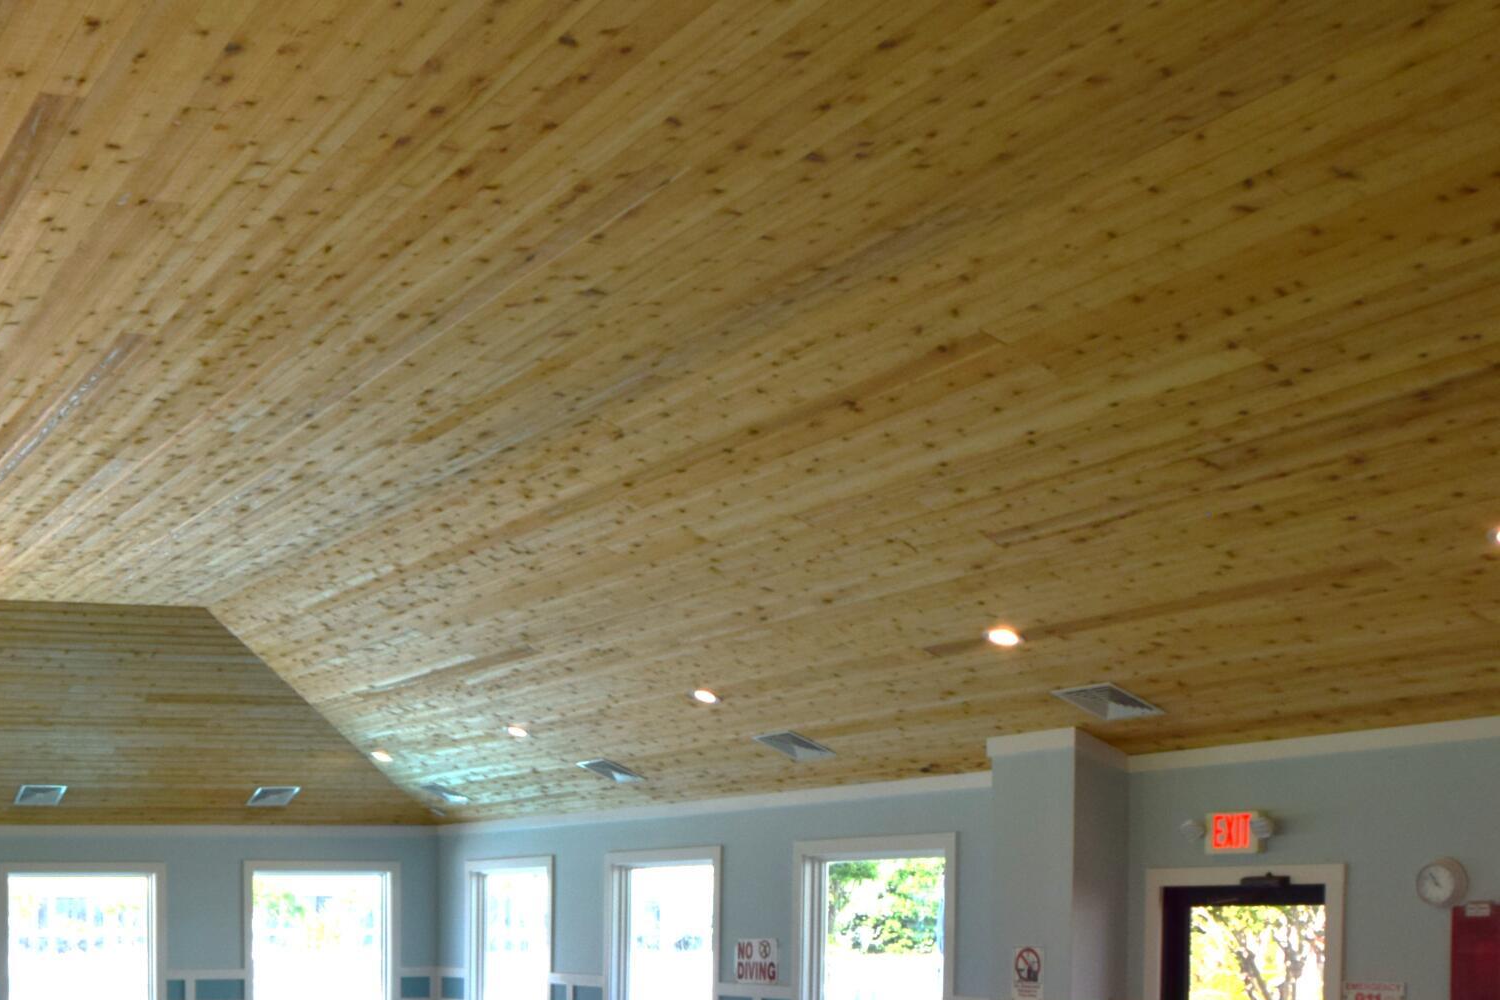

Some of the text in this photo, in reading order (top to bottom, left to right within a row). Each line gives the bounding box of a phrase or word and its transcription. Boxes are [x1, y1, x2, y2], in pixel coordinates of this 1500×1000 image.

[1212, 813, 1252, 849] EXIT
[737, 941, 753, 960] NO
[737, 961, 776, 981] DIVING
